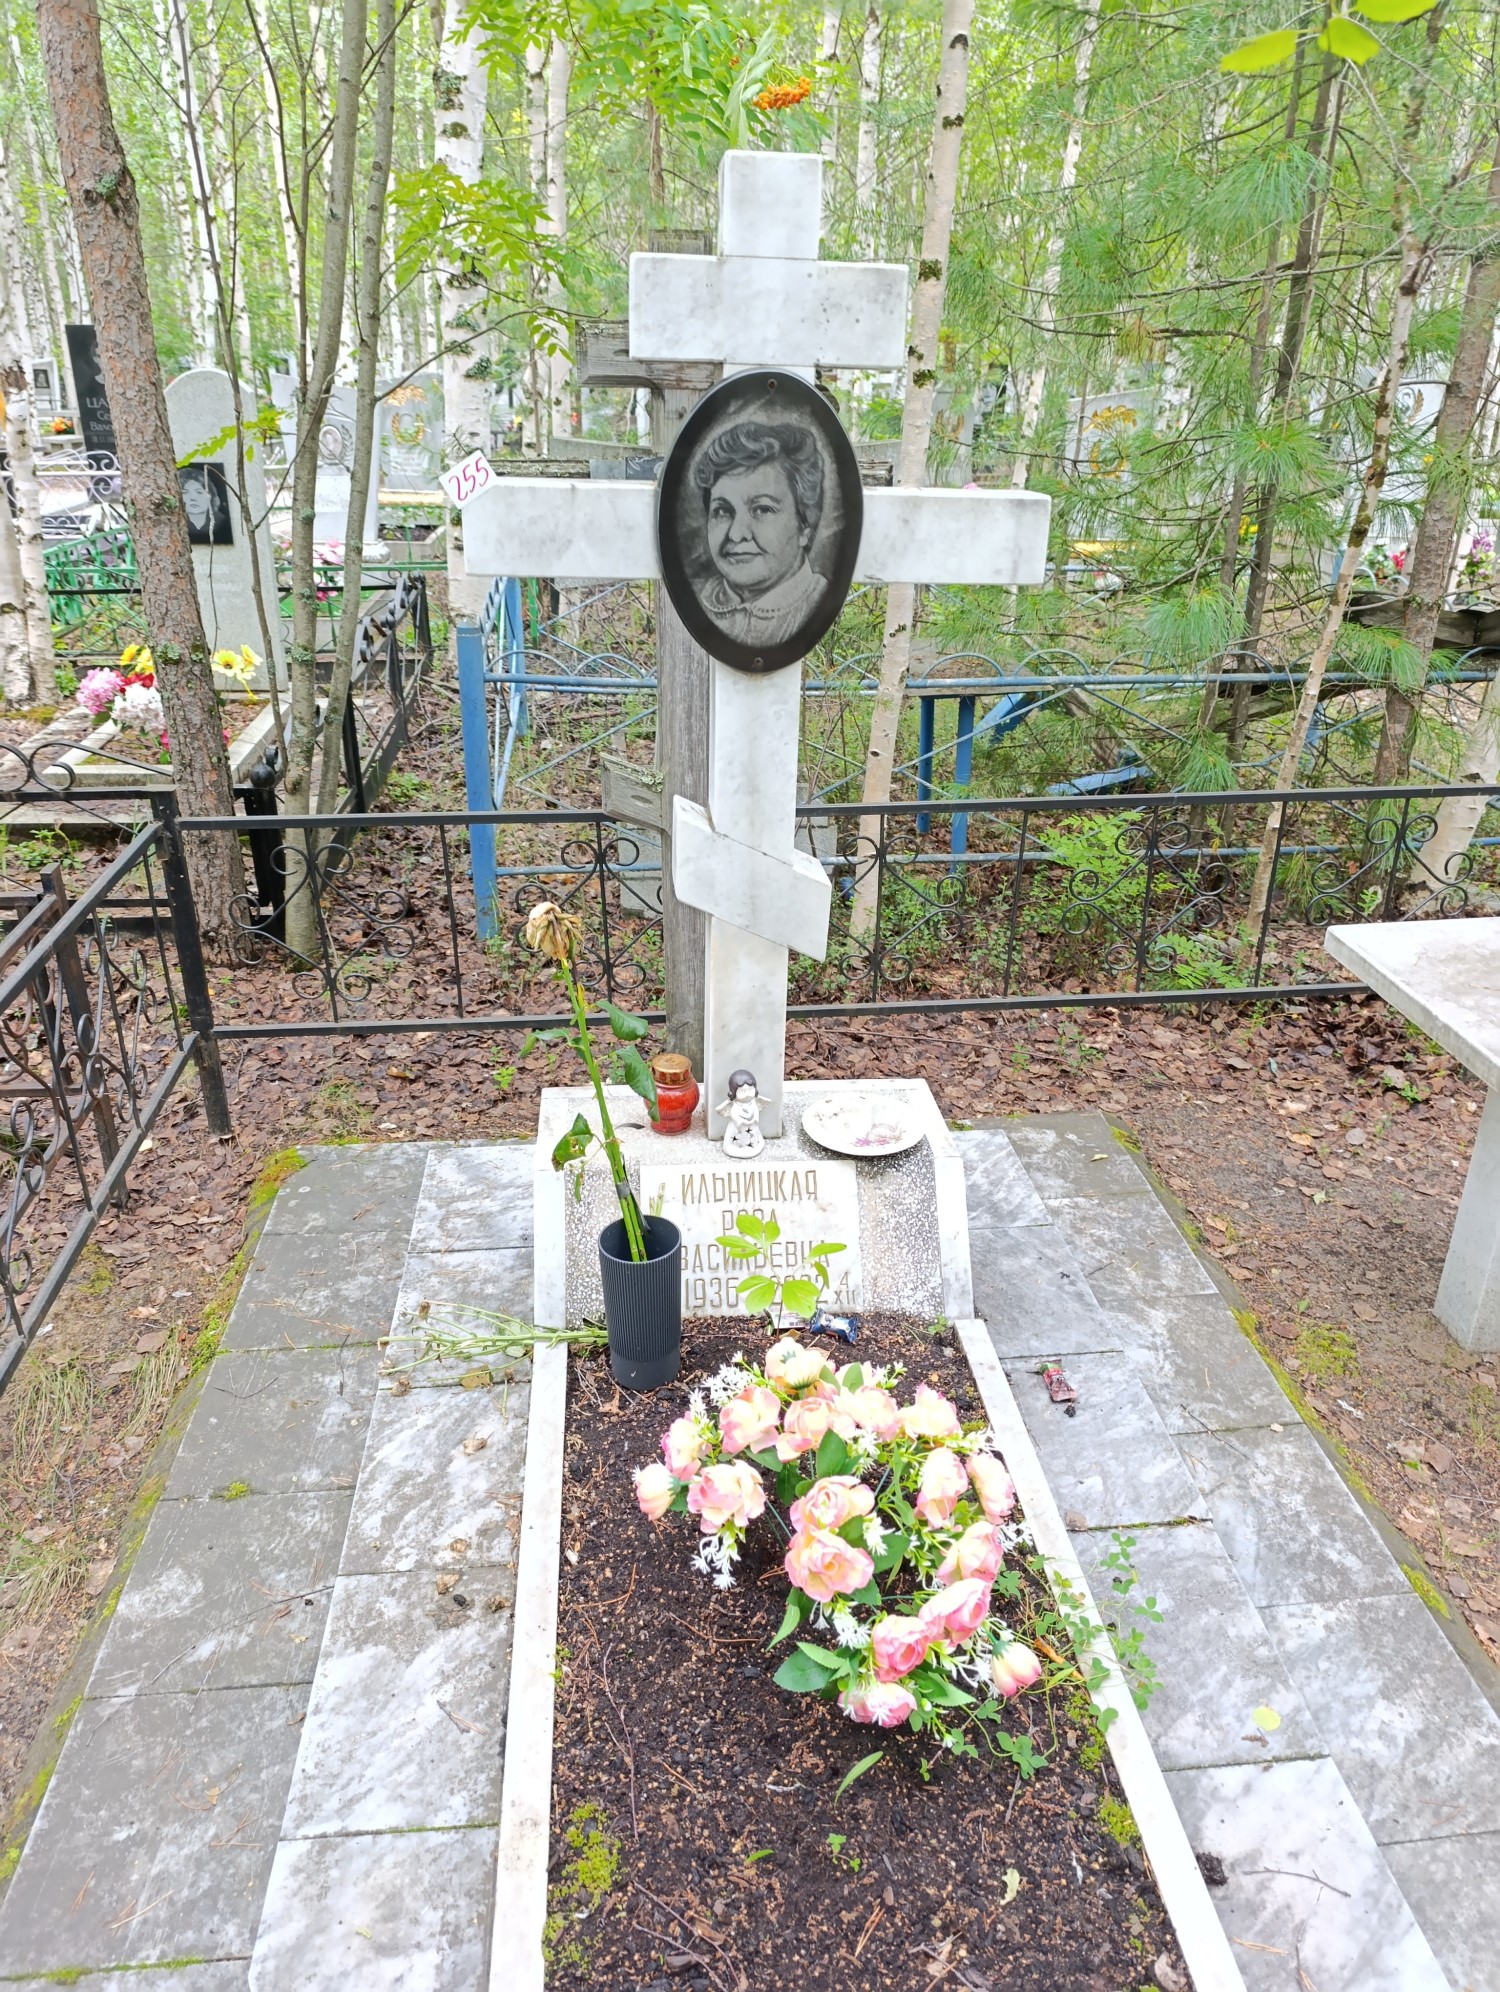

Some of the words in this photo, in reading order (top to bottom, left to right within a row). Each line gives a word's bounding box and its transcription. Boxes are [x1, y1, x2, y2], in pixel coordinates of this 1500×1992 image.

[448, 456, 489, 501] 255
[681, 1170, 818, 1205] ИЛЬНИЦКАЯ
[722, 1208, 780, 1237] РА
[685, 1277, 739, 1311] 1936
